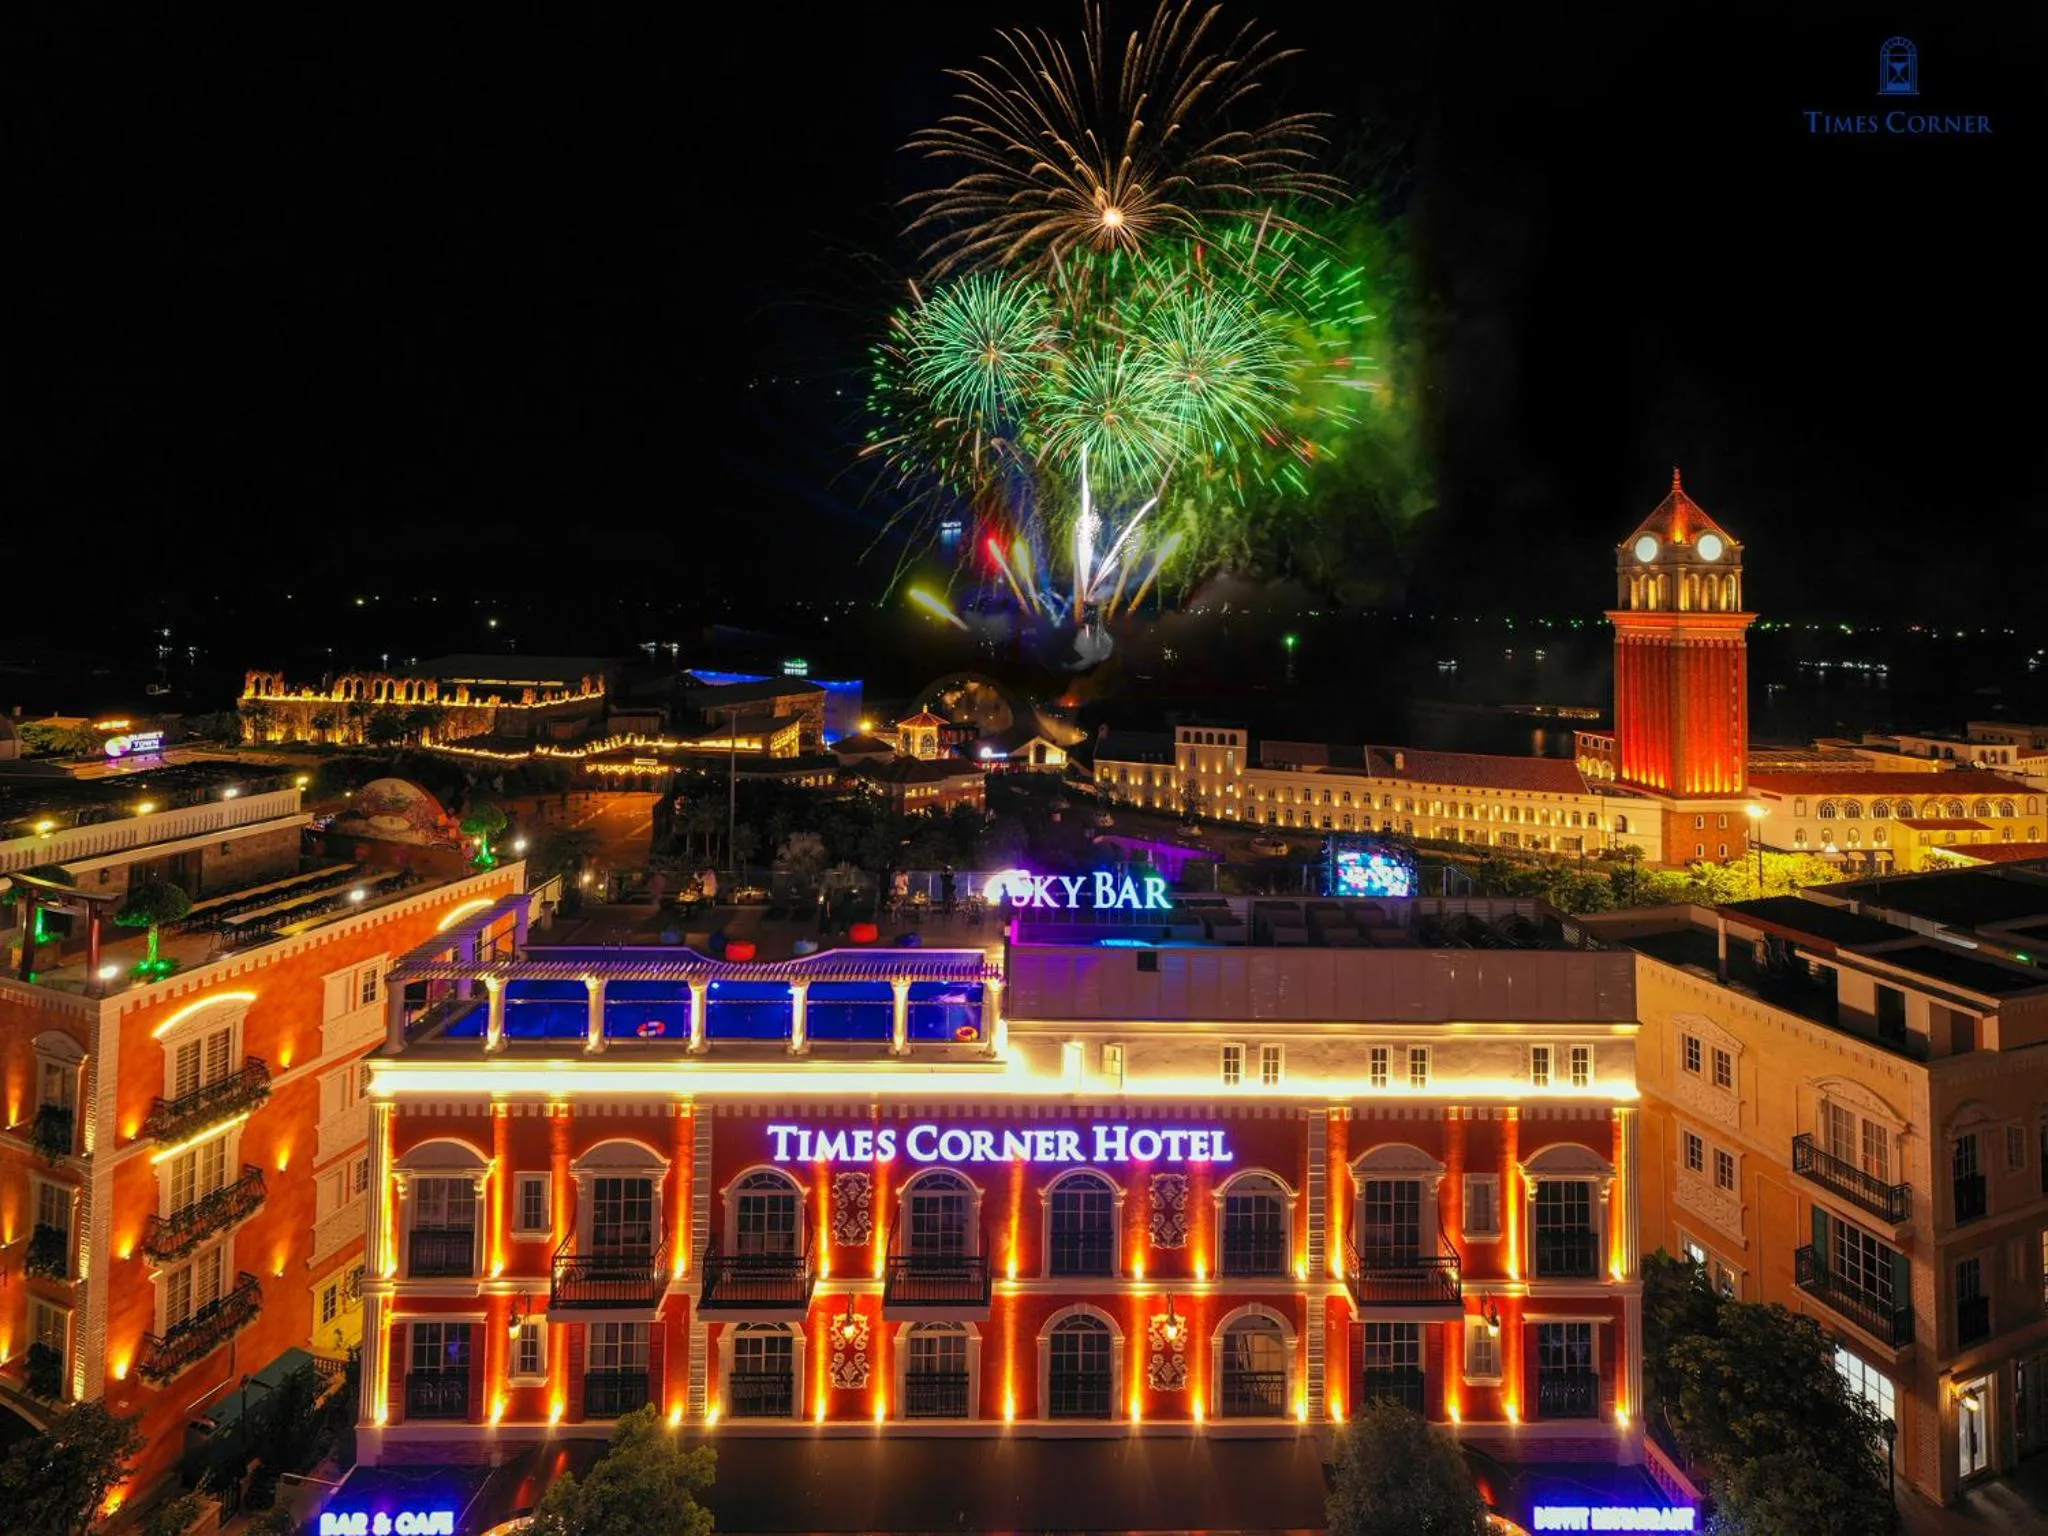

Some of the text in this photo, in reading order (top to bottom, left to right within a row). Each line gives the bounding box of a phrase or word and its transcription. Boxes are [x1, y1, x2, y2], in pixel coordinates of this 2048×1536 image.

[1093, 871, 1173, 909] BAR
[767, 1125, 1234, 1162] TIMES CORNER HOTEL
[320, 1511, 453, 1535] BAR & CAFE
